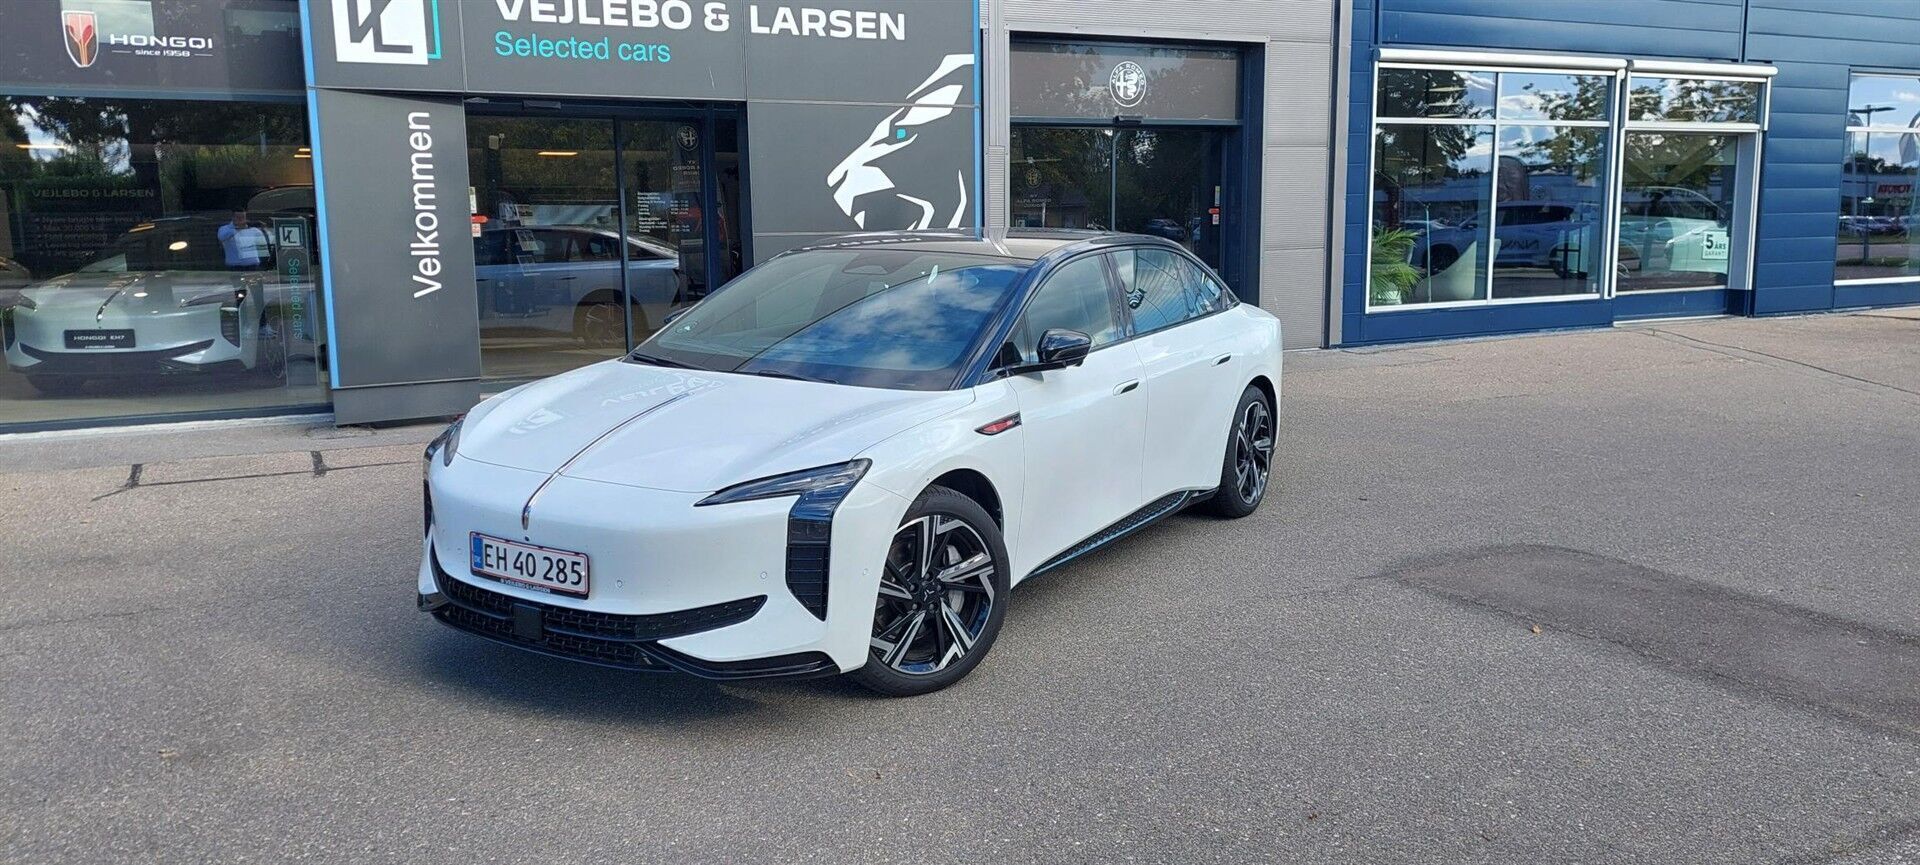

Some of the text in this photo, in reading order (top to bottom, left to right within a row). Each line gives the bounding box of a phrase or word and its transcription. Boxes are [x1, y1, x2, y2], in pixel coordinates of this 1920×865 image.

[495, 0, 906, 40] VEJLEBO & LARSEN
[109, 33, 213, 49] HONGQI
[135, 49, 161, 57] since
[494, 31, 671, 63] Selected cars
[32, 188, 89, 198] VEJLEBO
[103, 188, 154, 198] LARSEN
[407, 111, 442, 299] Velkommen
[1706, 234, 1714, 250] 5
[288, 258, 303, 340] Selected cars
[484, 543, 582, 586] EH 40 285
